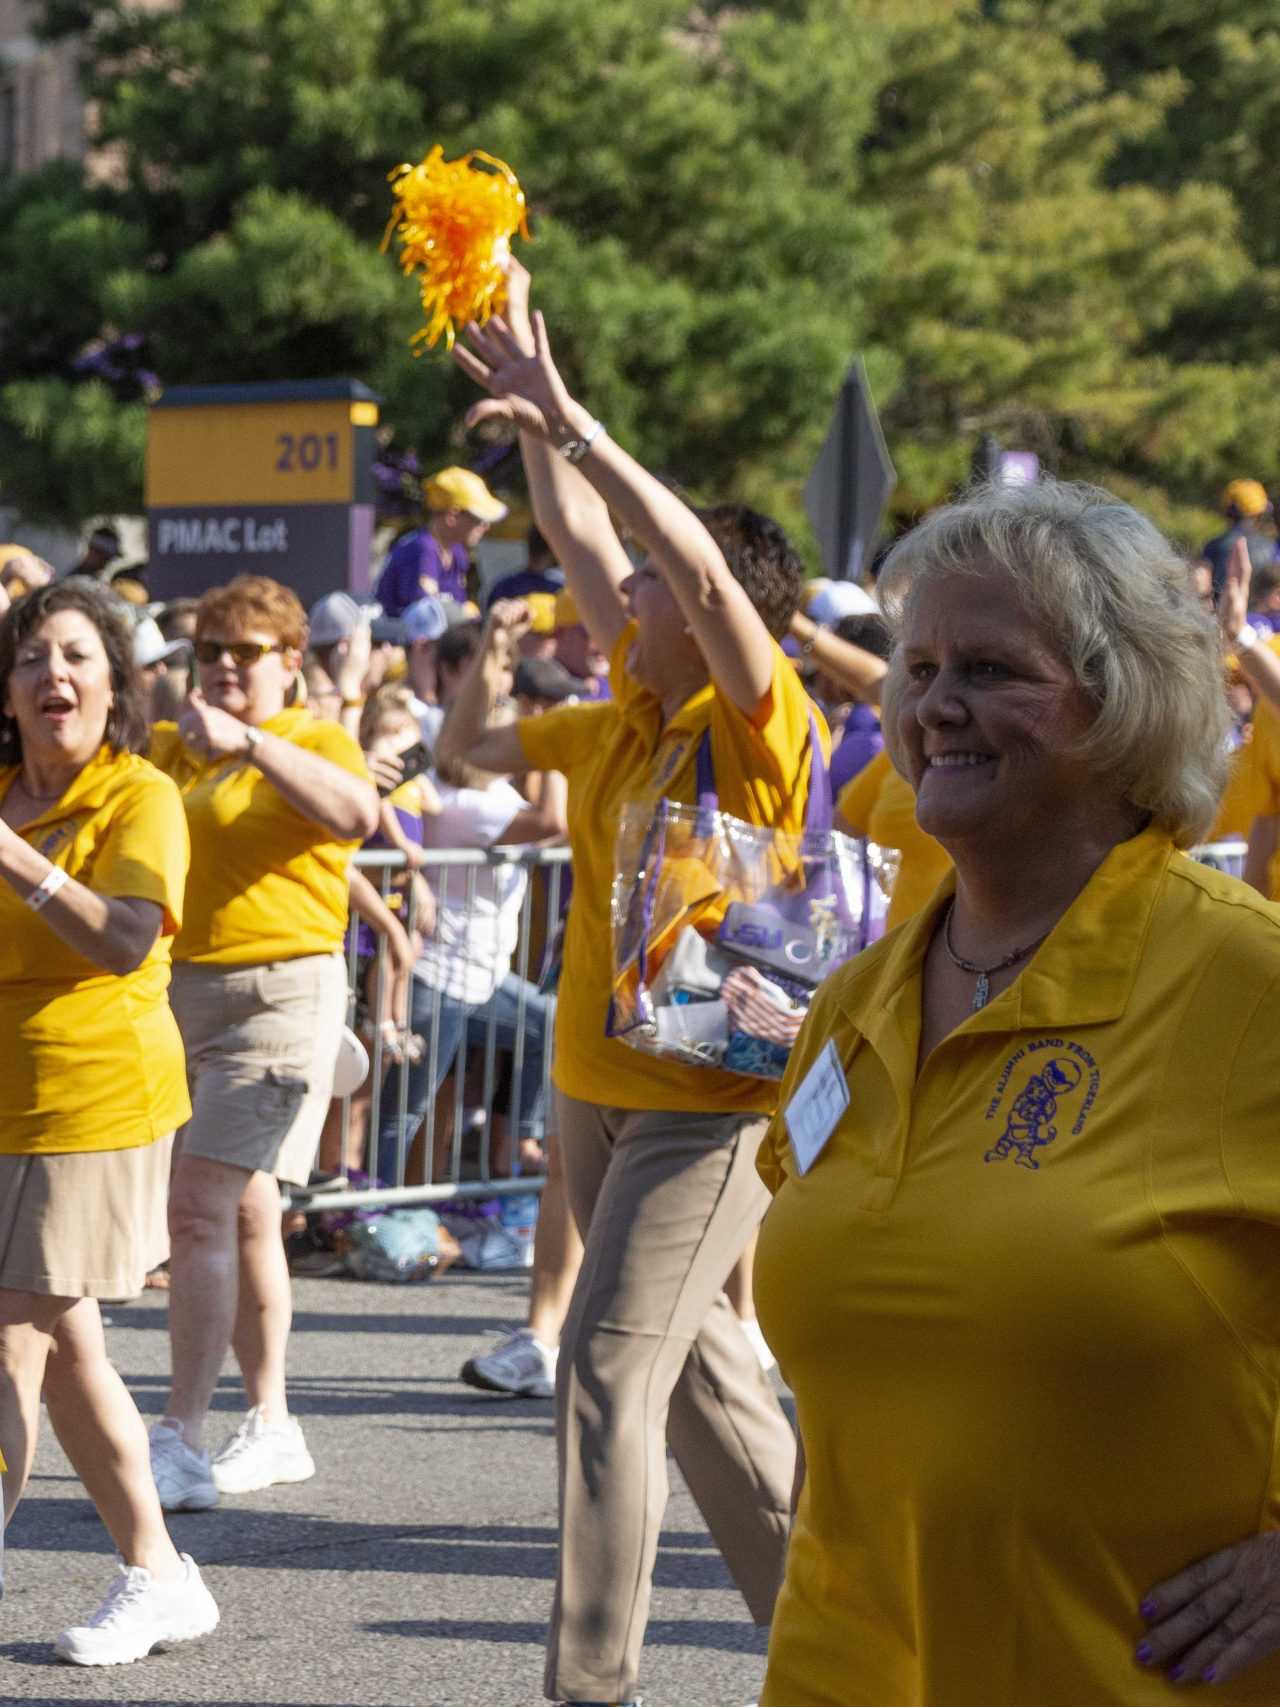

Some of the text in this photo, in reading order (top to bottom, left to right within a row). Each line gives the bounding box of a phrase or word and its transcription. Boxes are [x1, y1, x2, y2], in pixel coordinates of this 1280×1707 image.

[277, 432, 338, 472] 201
[158, 517, 288, 553] PMAC Lot
[720, 924, 783, 949] LSU
[985, 1097, 1001, 1120] THE
[996, 1049, 1026, 1093] ALUMNI
[1027, 1038, 1064, 1052] BAND
[1067, 1041, 1097, 1068] FROM
